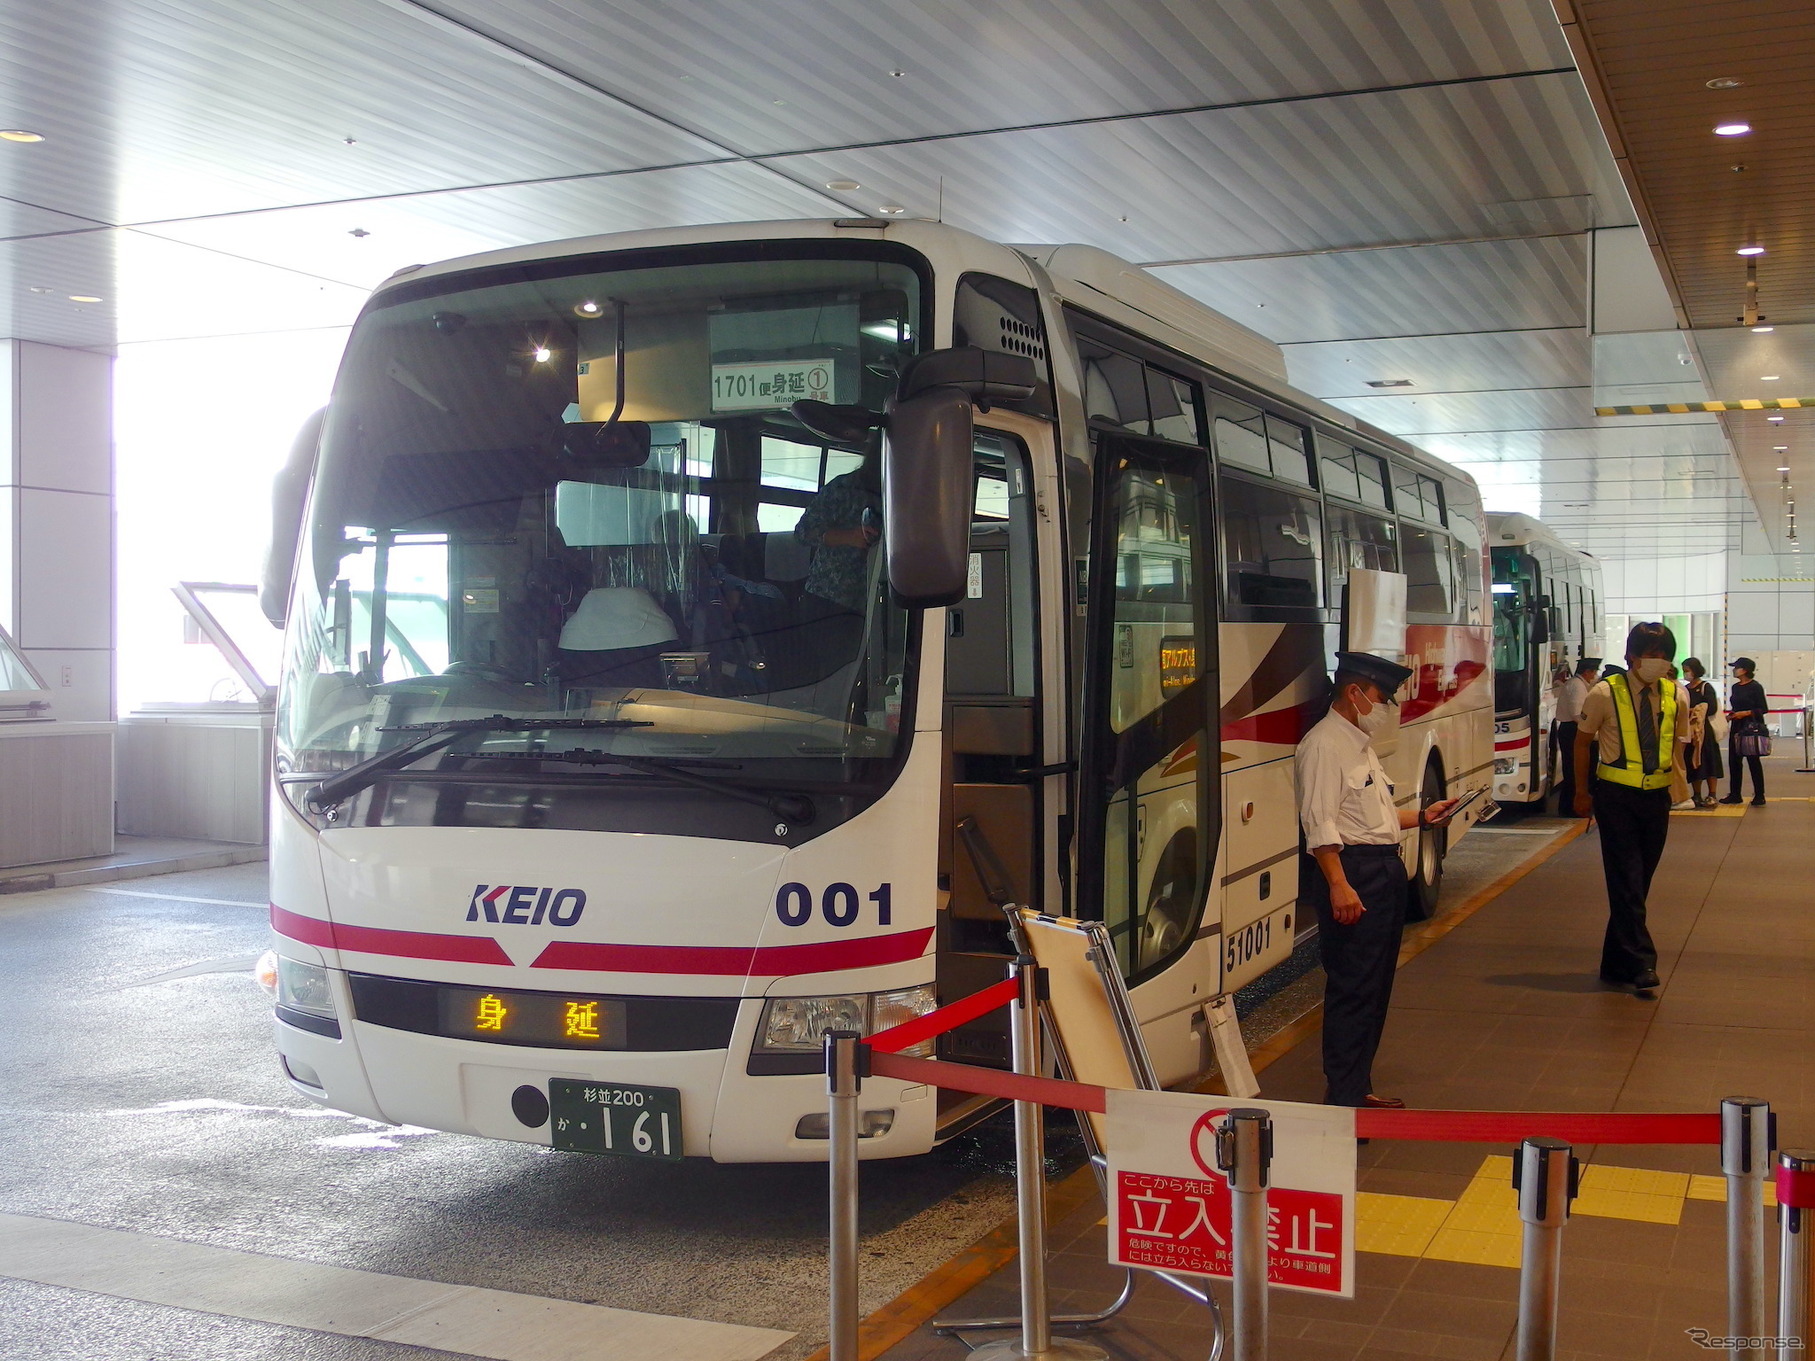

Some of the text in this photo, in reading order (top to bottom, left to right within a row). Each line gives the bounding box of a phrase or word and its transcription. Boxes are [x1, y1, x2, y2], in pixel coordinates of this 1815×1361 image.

[969, 554, 980, 587] 消火器
[466, 884, 587, 927] KEIO
[776, 882, 891, 927] 001
[1226, 917, 1271, 973] 51001
[1124, 1174, 1215, 1195] ここから先は
